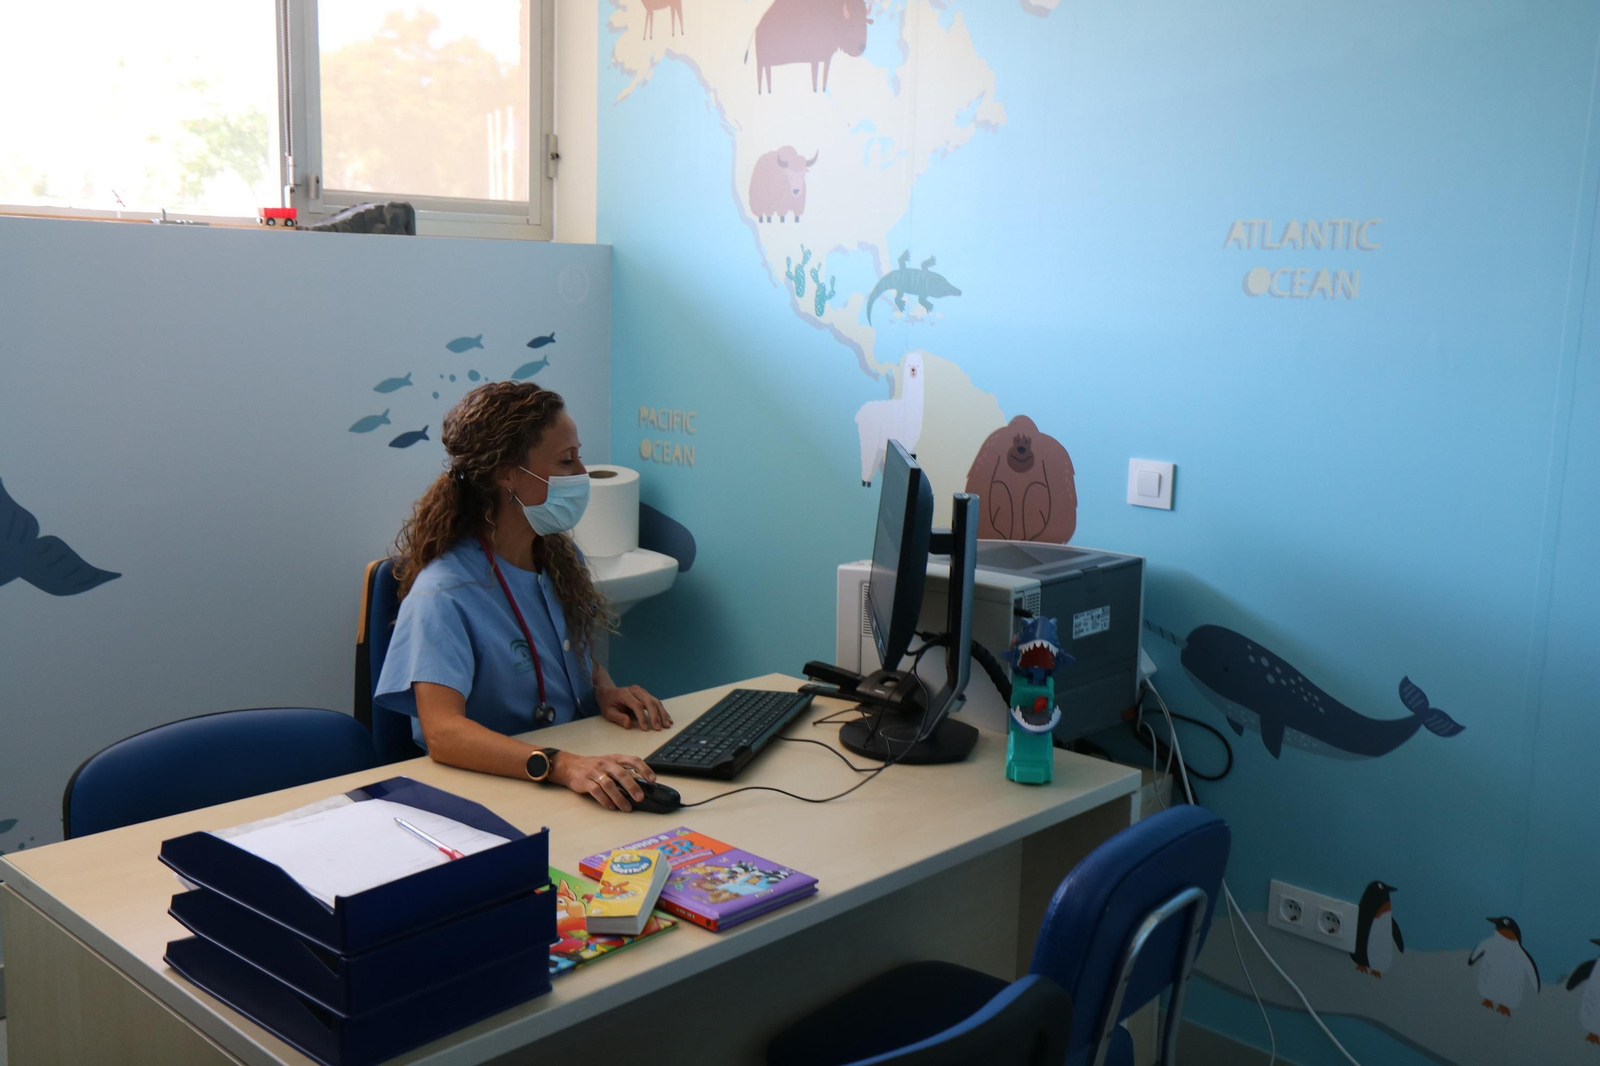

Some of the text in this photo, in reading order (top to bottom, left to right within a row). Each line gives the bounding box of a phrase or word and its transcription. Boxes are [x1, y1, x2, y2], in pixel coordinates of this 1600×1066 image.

[1223, 217, 1383, 250] ATLANTIC
[1243, 266, 1361, 299] OCEAN
[639, 405, 698, 434] PACIFIC
[640, 438, 697, 467] OCEAN
[654, 839, 703, 858] ER
